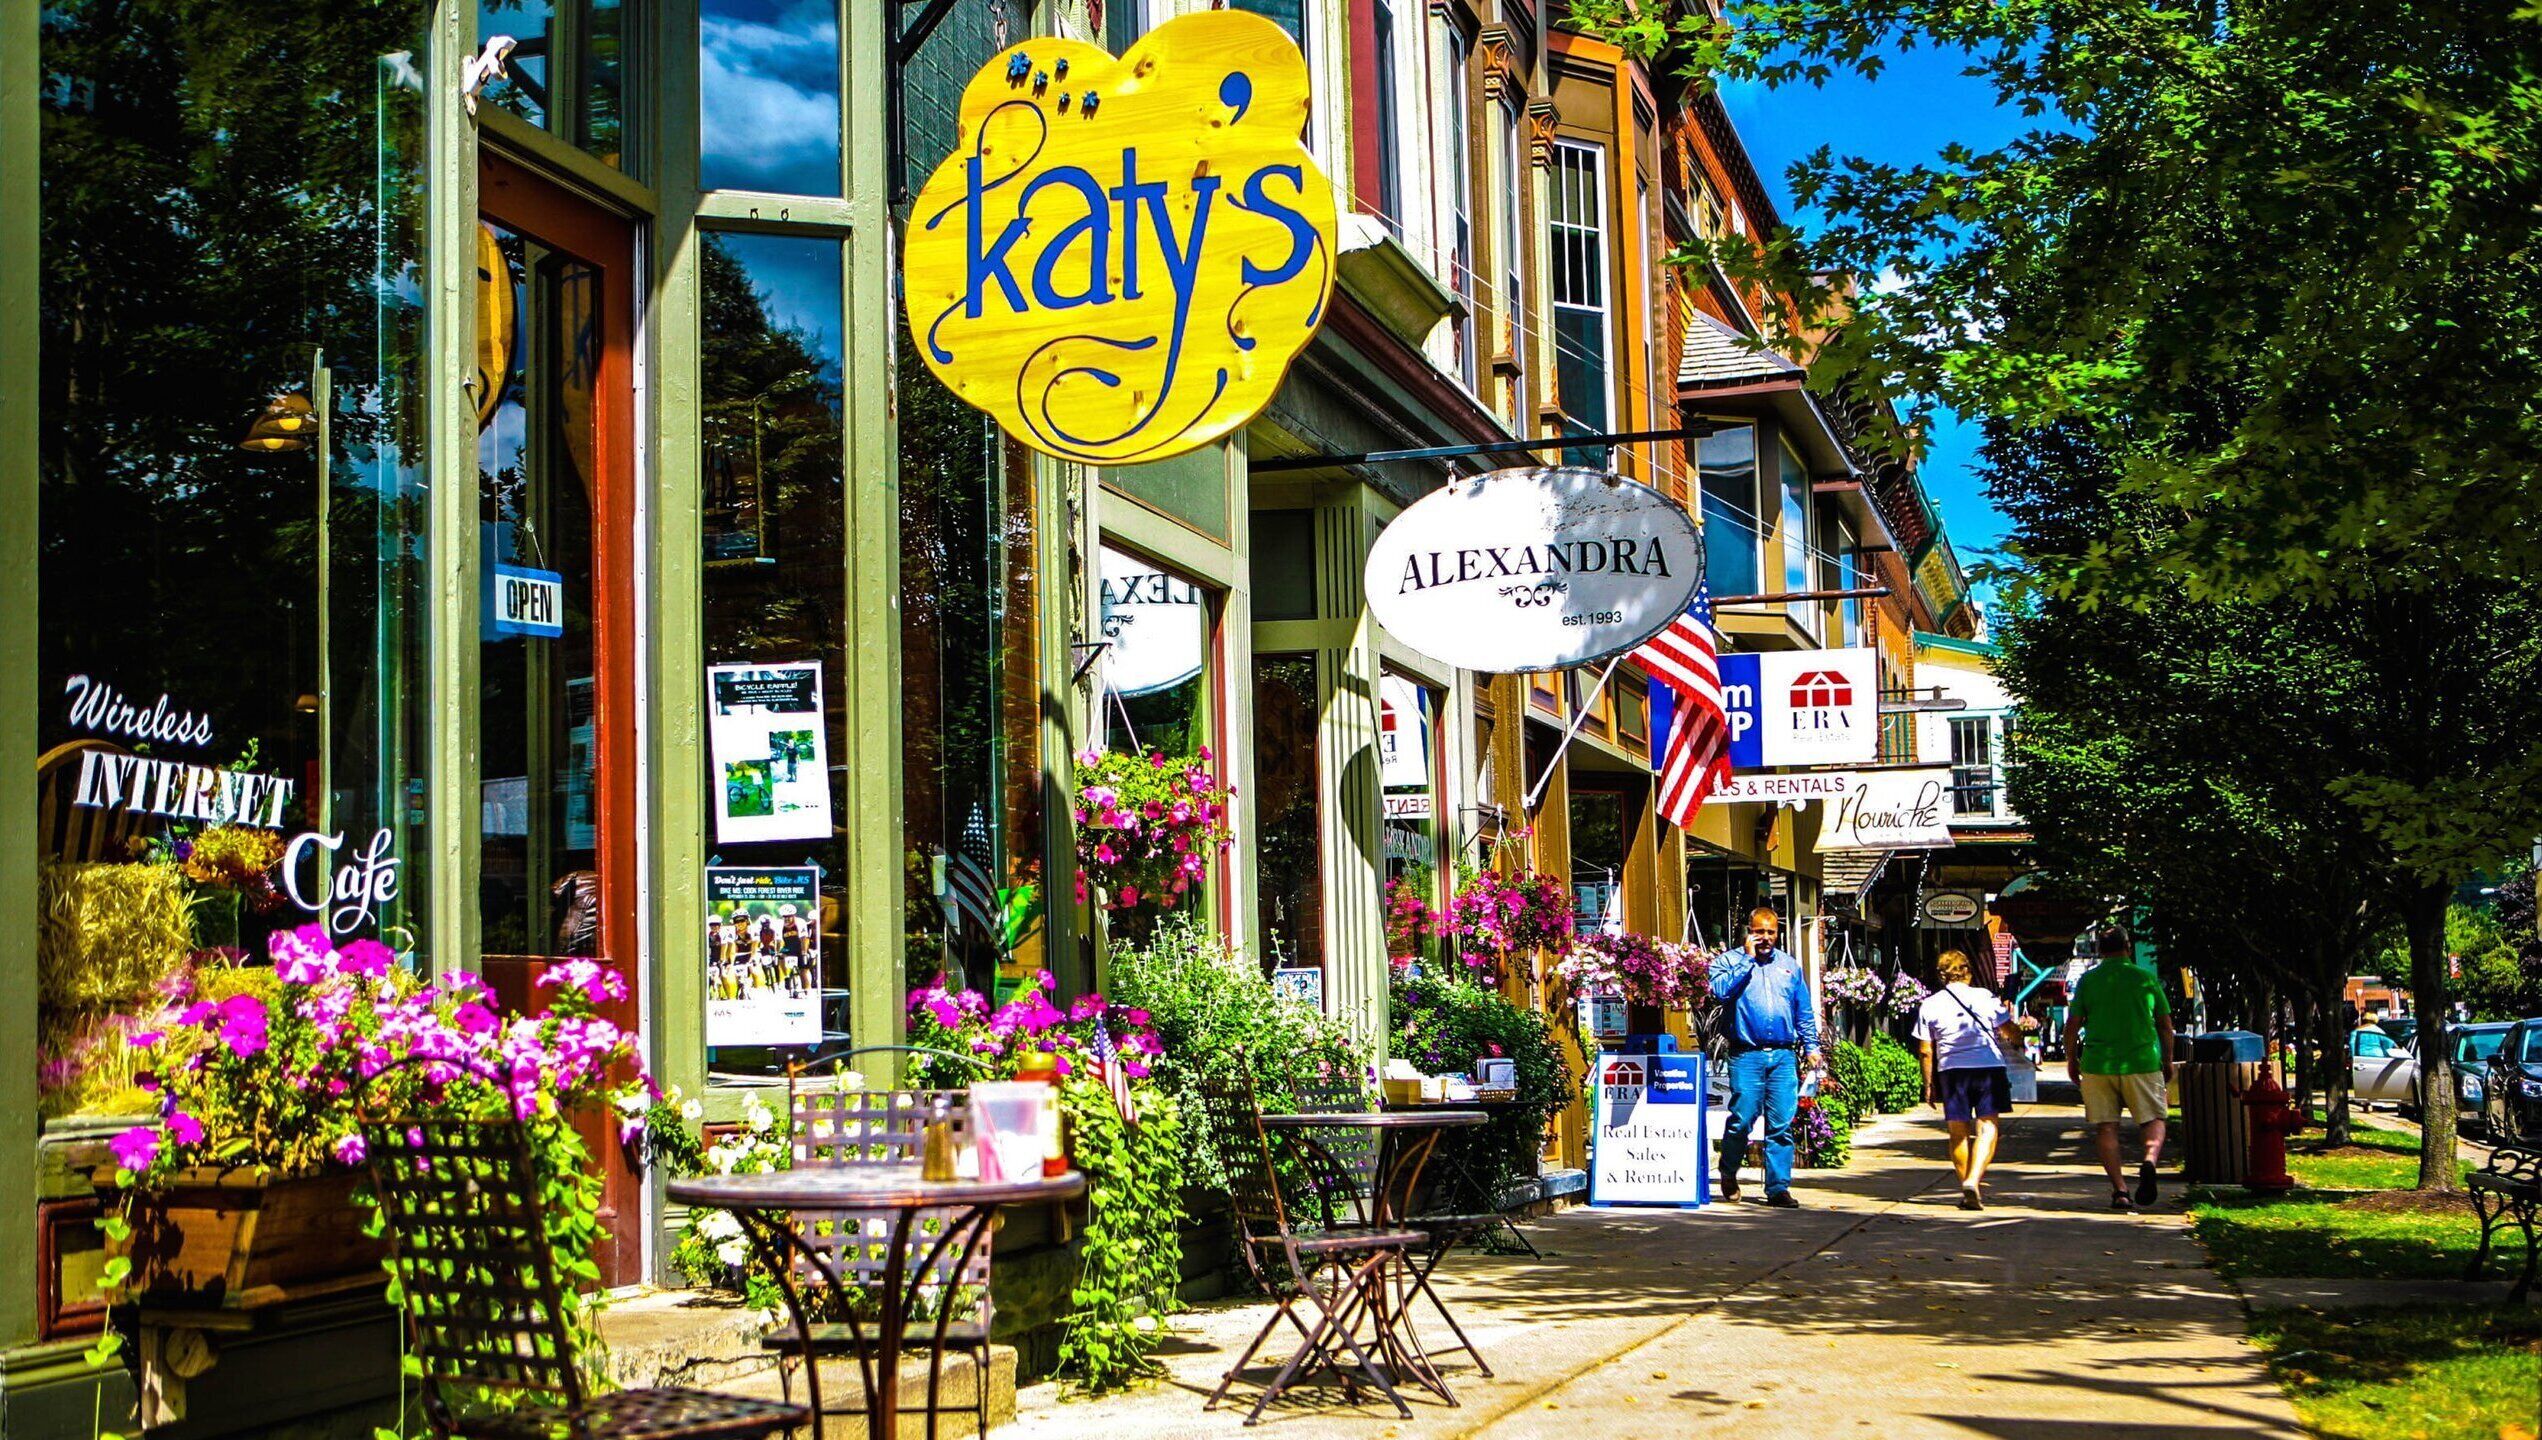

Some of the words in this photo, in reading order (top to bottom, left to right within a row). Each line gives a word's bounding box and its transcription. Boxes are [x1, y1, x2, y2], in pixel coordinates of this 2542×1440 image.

[926, 71, 1328, 459] katy's
[1399, 536, 1672, 595] ALEXANDRA
[506, 579, 553, 623] OPEN
[65, 673, 214, 746] Wireless
[1793, 710, 1851, 730] ERA
[73, 749, 295, 829] INTERNET
[1747, 781, 1758, 795] &
[1765, 777, 1845, 794] RENTALS
[283, 828, 401, 933] Cafe
[714, 875, 736, 884] Don't
[1654, 1069, 1687, 1078] Vacation
[1604, 1087, 1641, 1100] ERA
[1654, 1081, 1694, 1091] Properties
[1604, 1125, 1637, 1138] Real
[1644, 1125, 1692, 1138] Estate
[1627, 1148, 1667, 1161] Sales
[1607, 1172, 1618, 1183] &
[1626, 1170, 1685, 1184] Rentals
